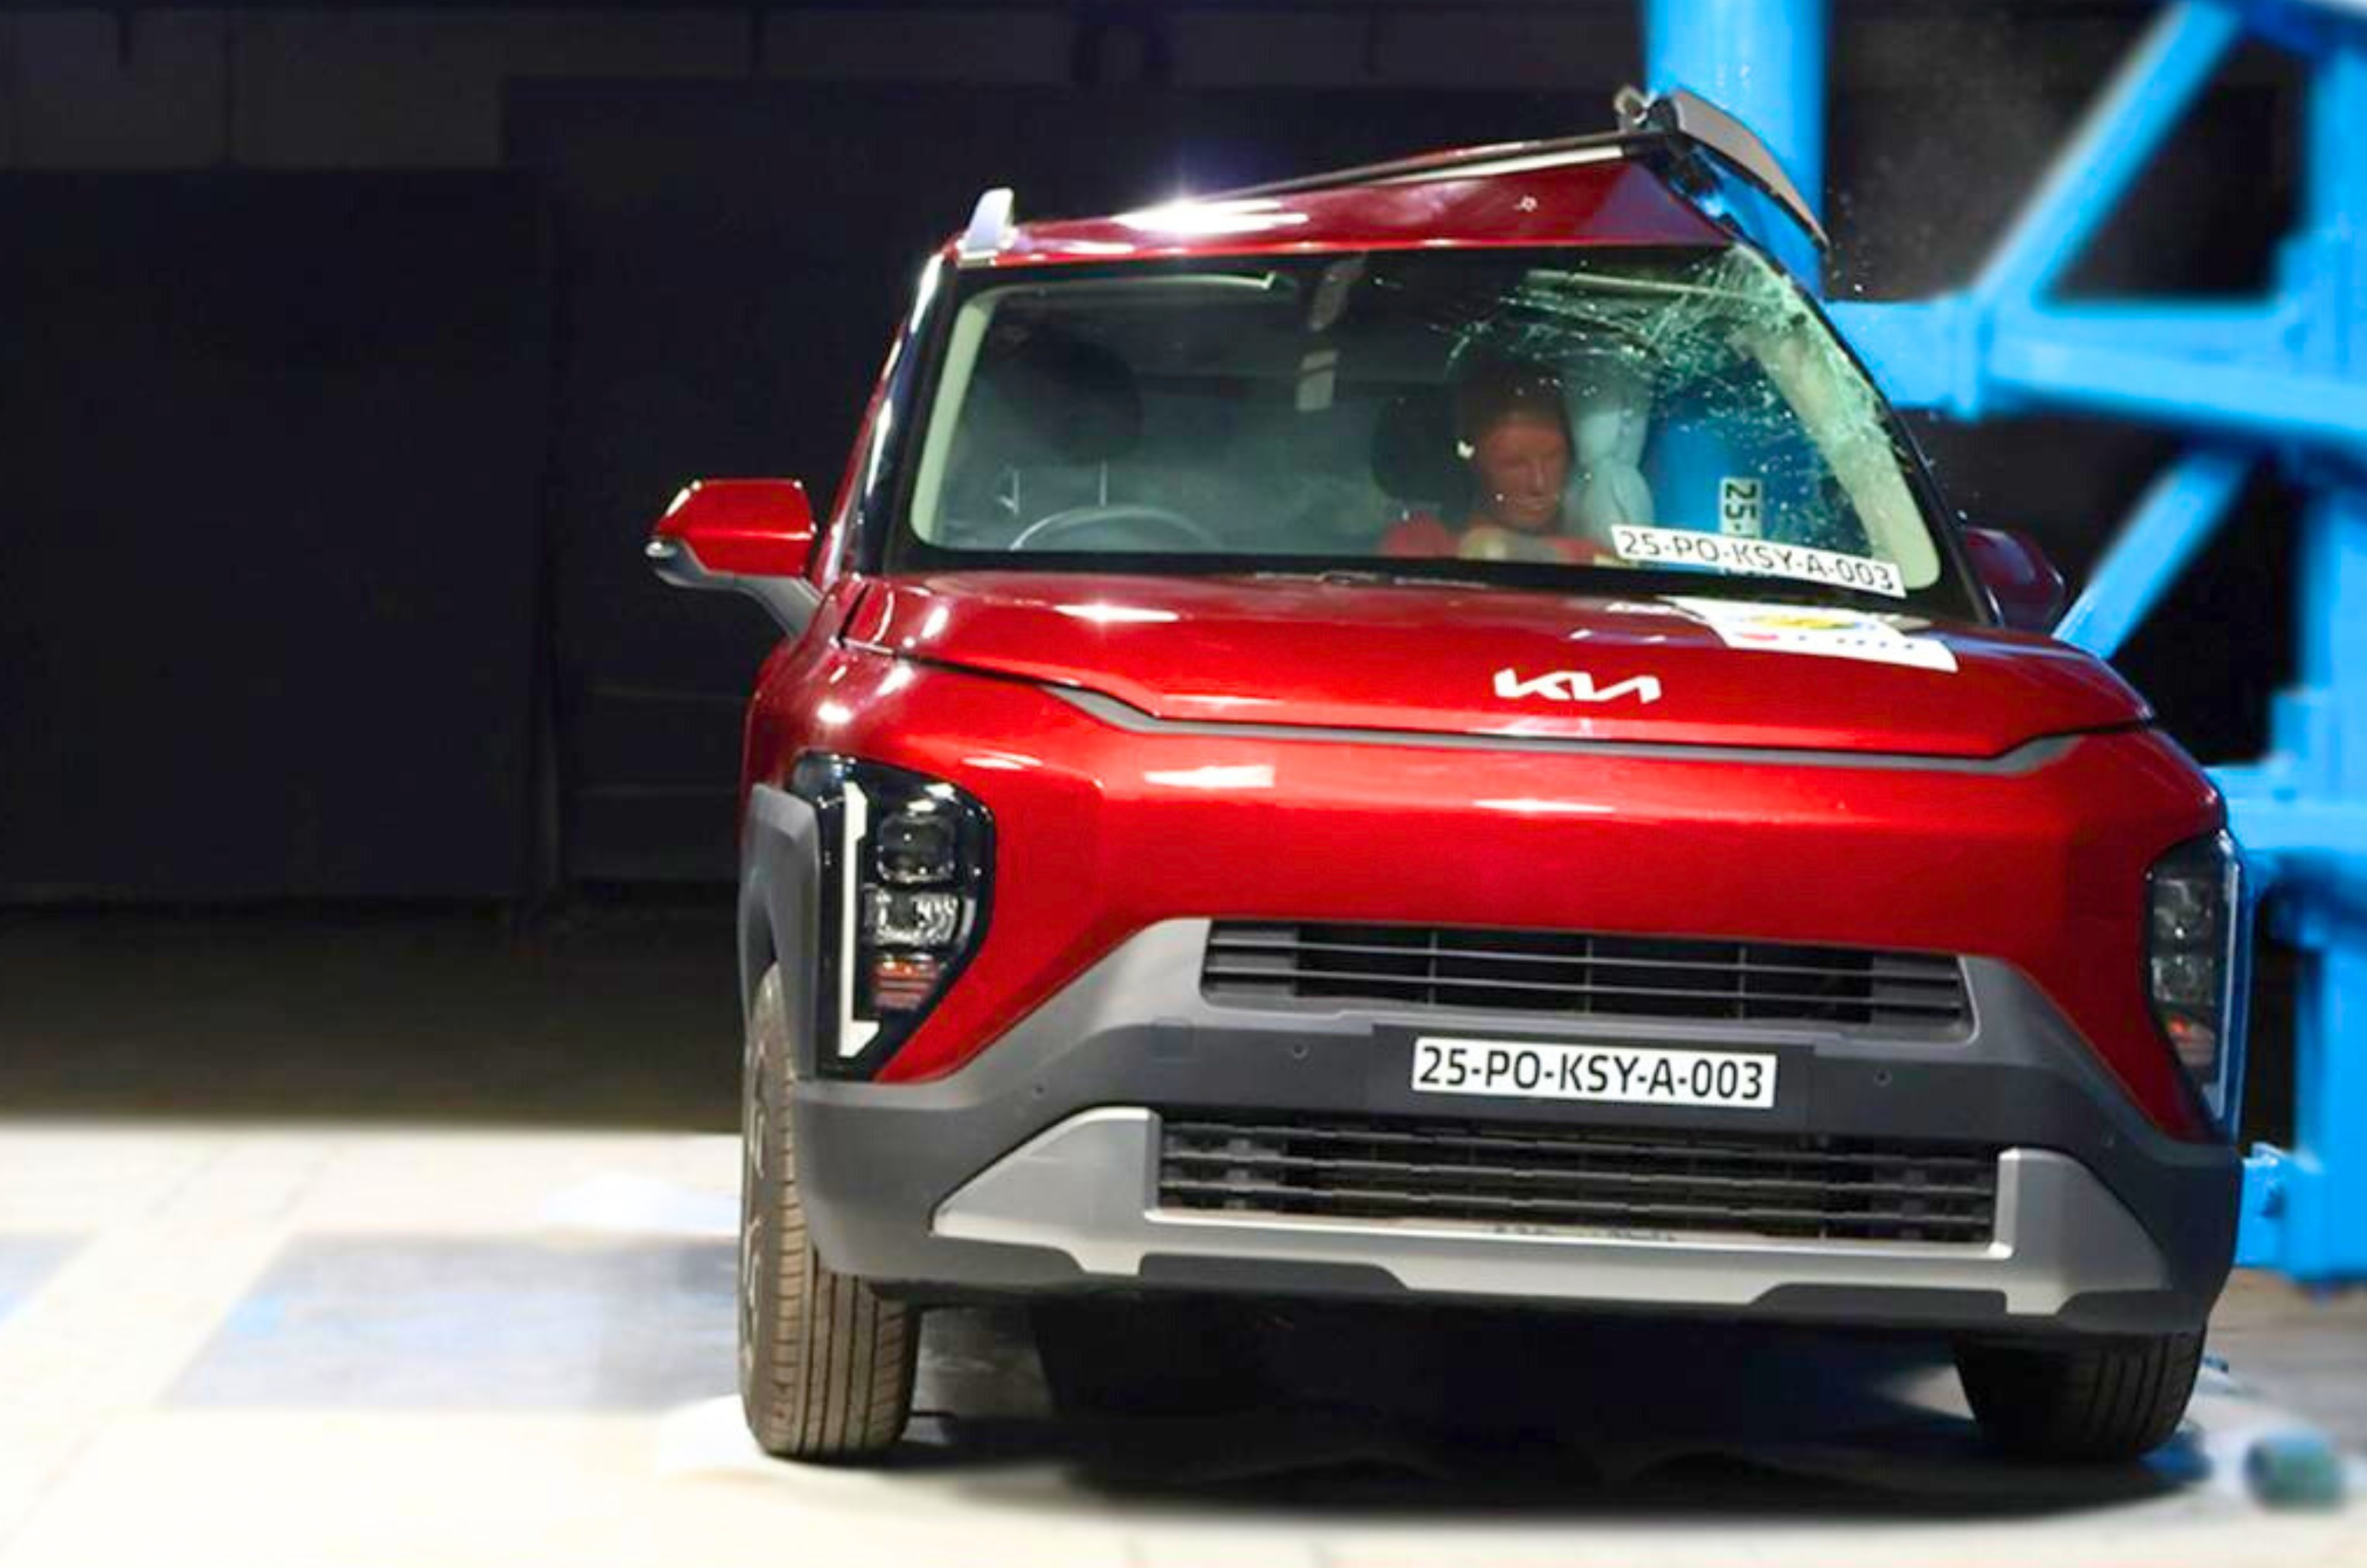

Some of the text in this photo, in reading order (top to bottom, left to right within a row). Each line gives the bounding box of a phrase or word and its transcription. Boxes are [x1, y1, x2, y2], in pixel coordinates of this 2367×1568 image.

[1725, 482, 1757, 538] 25-
[1620, 530, 1894, 591] 25-PO-KSY-A-003
[1493, 668, 1661, 703] KIA
[1418, 1045, 1764, 1100] 25-PO-KSY-A-003
